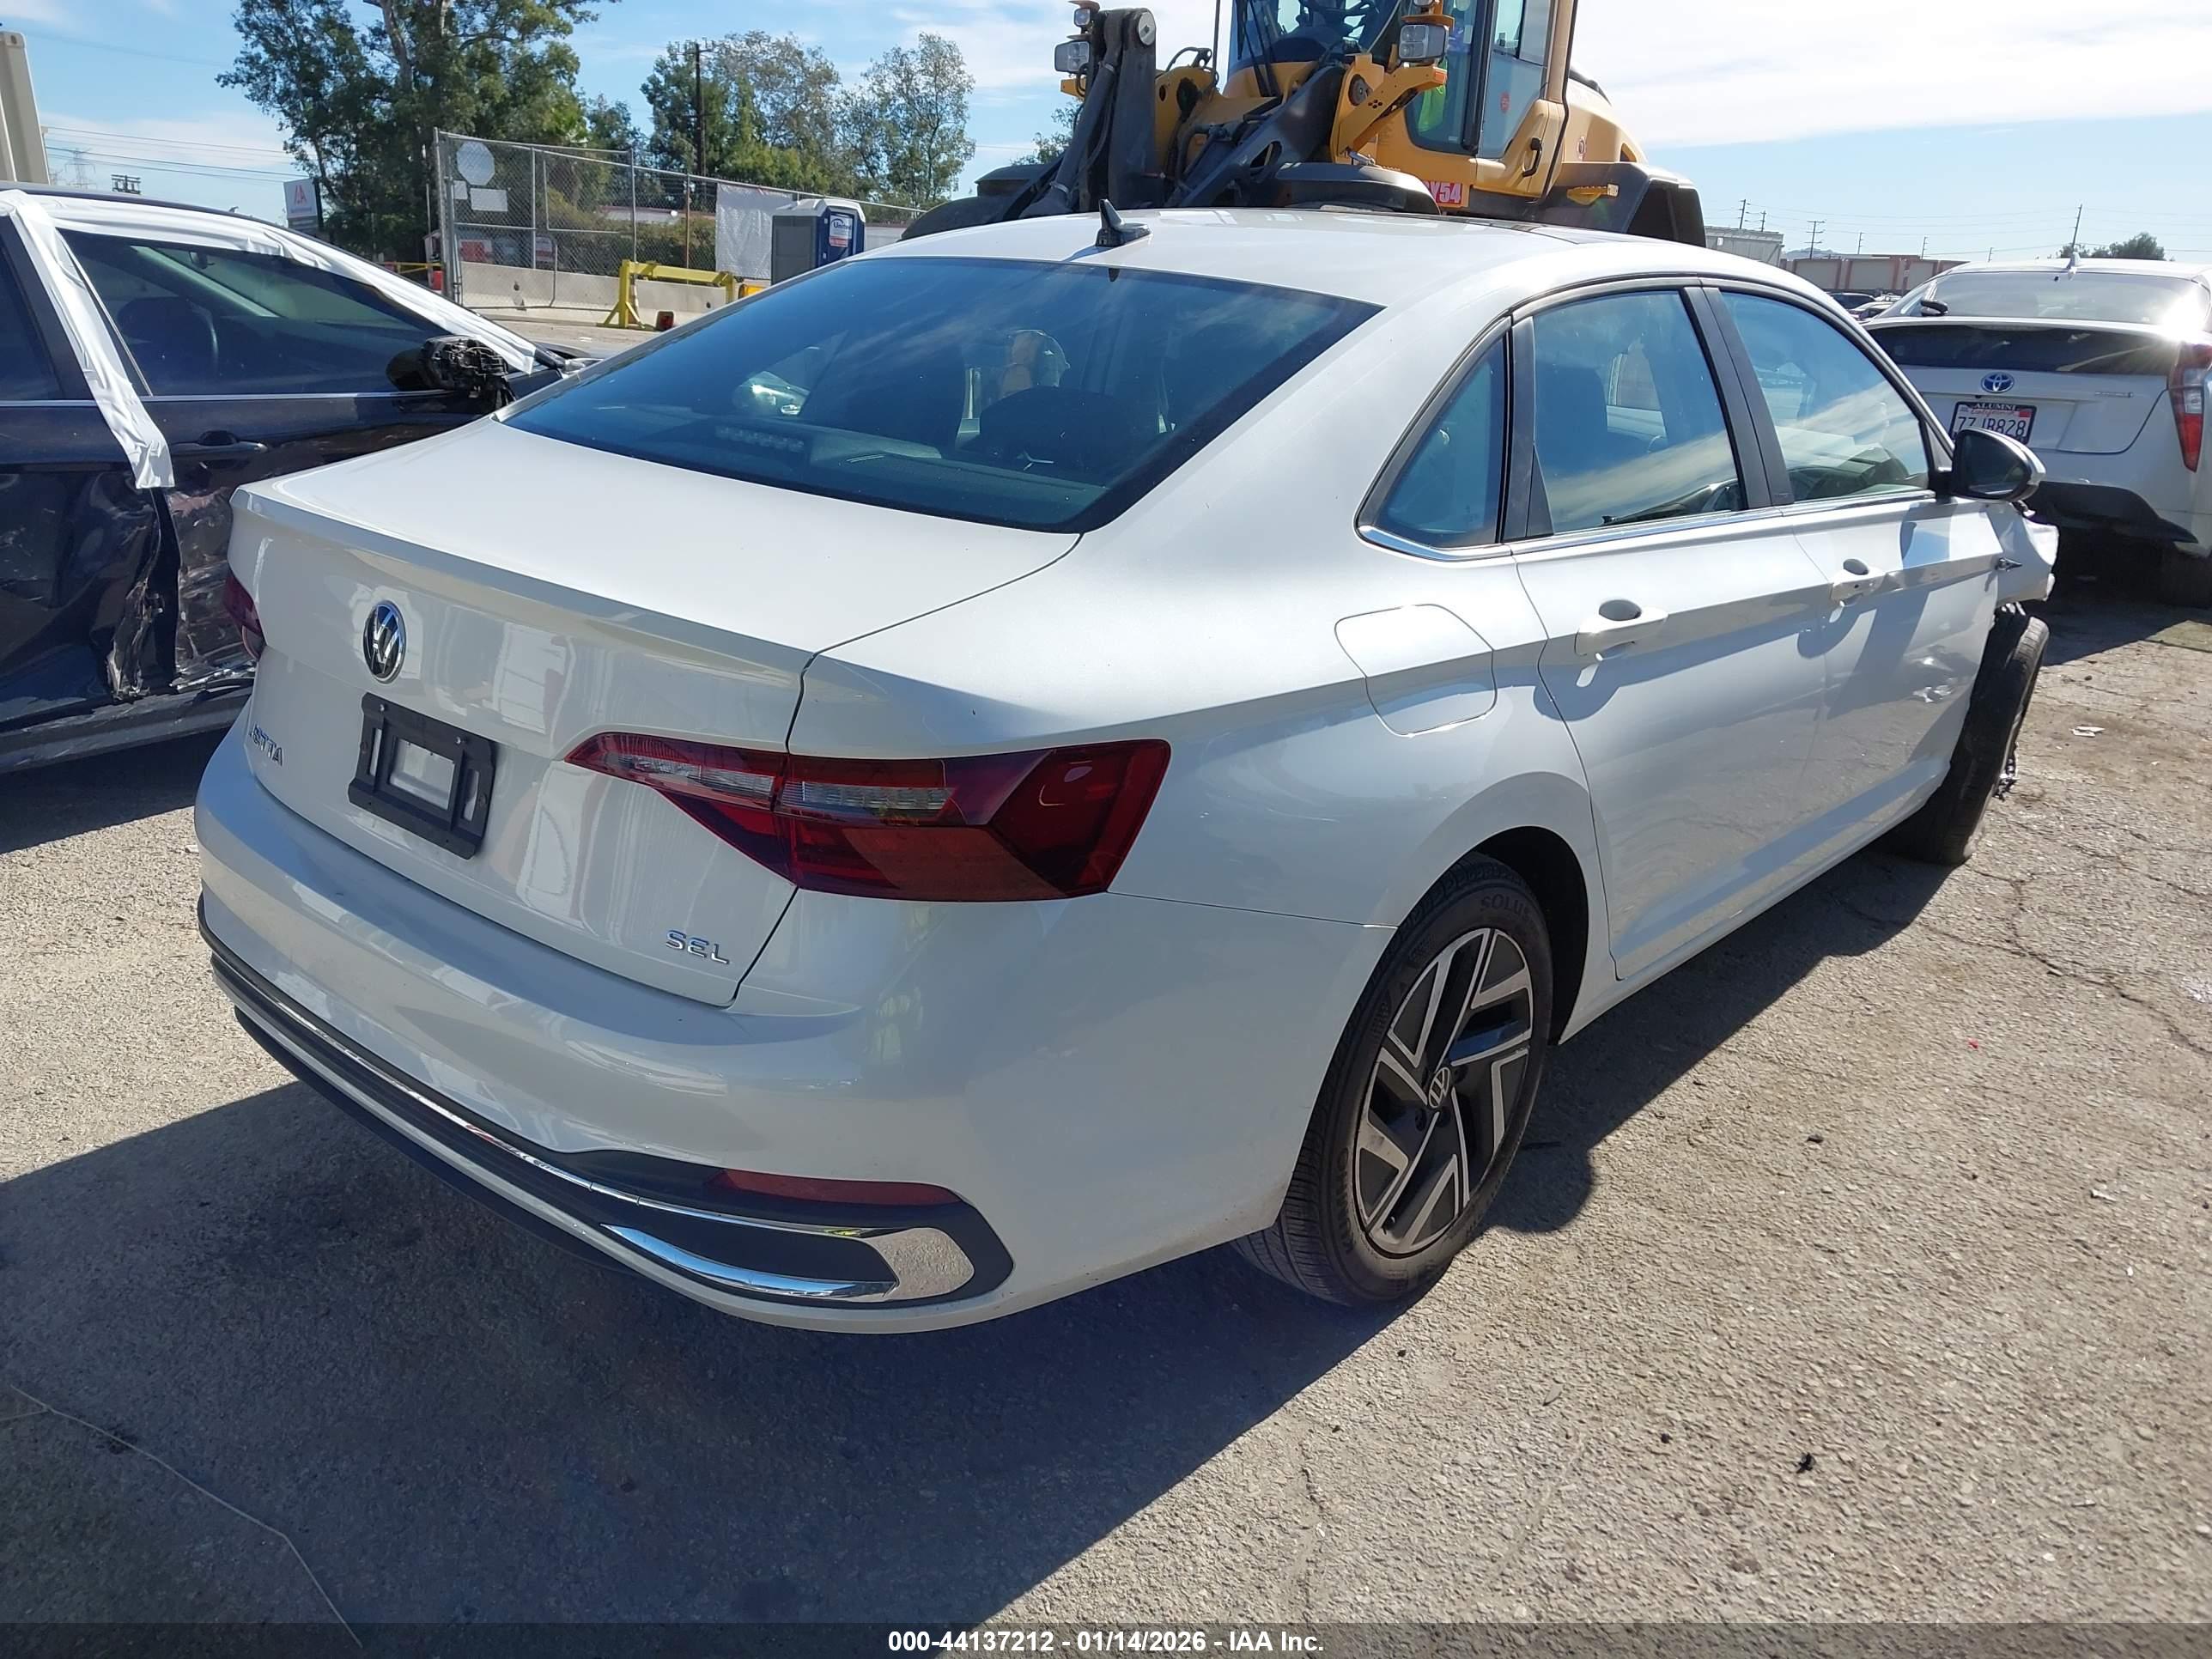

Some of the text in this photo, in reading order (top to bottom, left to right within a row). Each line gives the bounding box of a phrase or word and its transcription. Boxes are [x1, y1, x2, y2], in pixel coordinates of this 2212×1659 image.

[1423, 180, 1462, 204] Y54
[1975, 402, 2016, 411] ALUMNI
[665, 930, 730, 965] SEL
